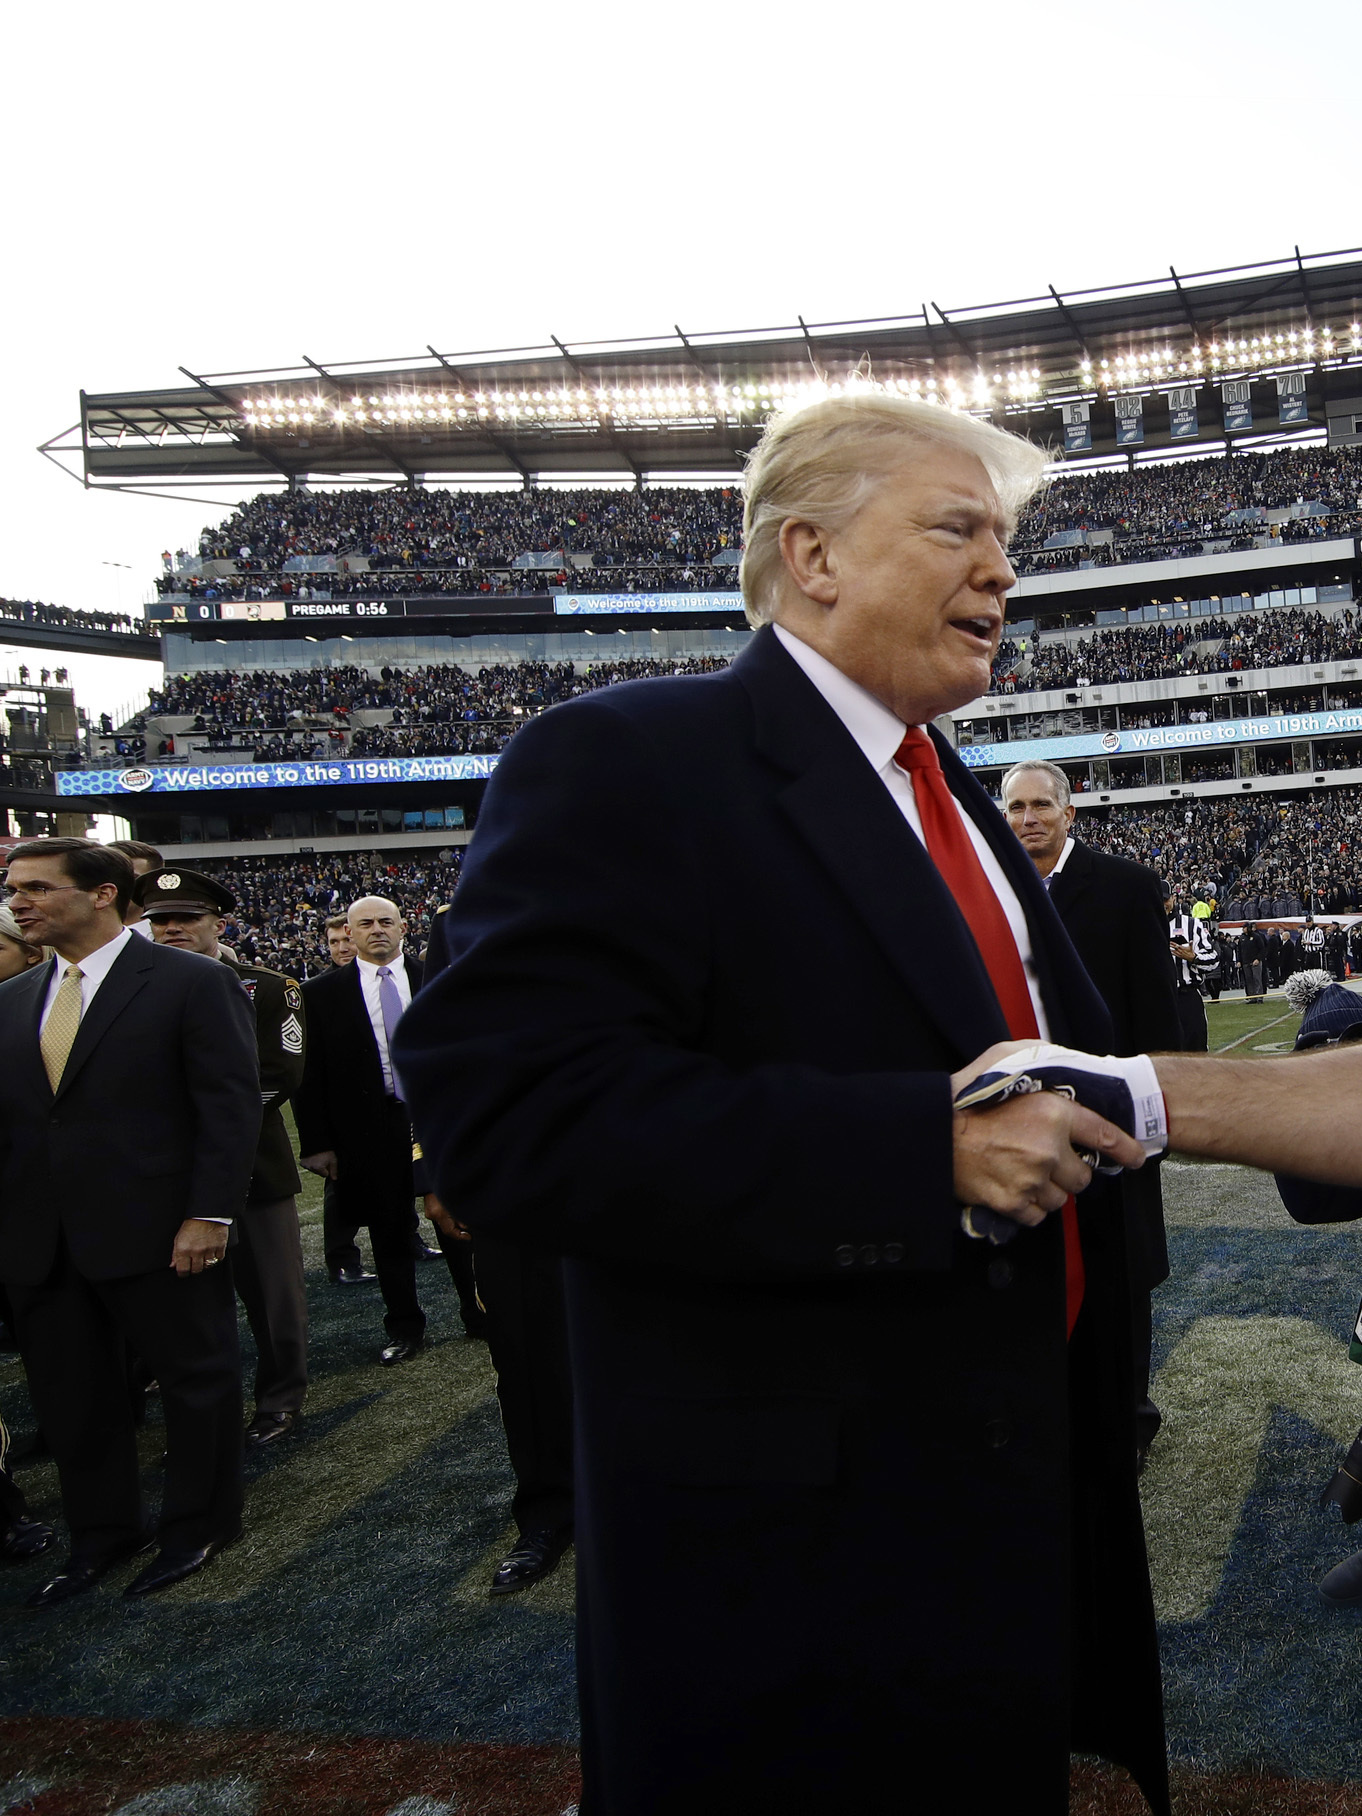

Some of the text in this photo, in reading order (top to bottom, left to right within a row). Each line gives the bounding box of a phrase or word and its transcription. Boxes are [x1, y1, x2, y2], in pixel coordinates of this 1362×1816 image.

[1224, 381, 1249, 404] 60
[1280, 373, 1303, 396] 70
[1116, 396, 1141, 419] 92
[1170, 388, 1194, 411] 44
[1069, 404, 1083, 424] 5
[172, 606, 209, 618] N 0
[225, 605, 234, 617] 0
[292, 603, 388, 615] PREGAME 0:56
[588, 598, 642, 609] Welcome
[645, 597, 656, 607] to
[658, 597, 678, 607] the
[681, 597, 709, 607] 119th
[1132, 727, 1212, 747] Welcome
[1217, 725, 1236, 738] to
[1241, 722, 1270, 736] the
[1274, 717, 1319, 732] 119th
[164, 769, 270, 787] Welcome
[276, 767, 299, 784] to
[305, 764, 342, 781] the
[346, 762, 402, 780] 119th
